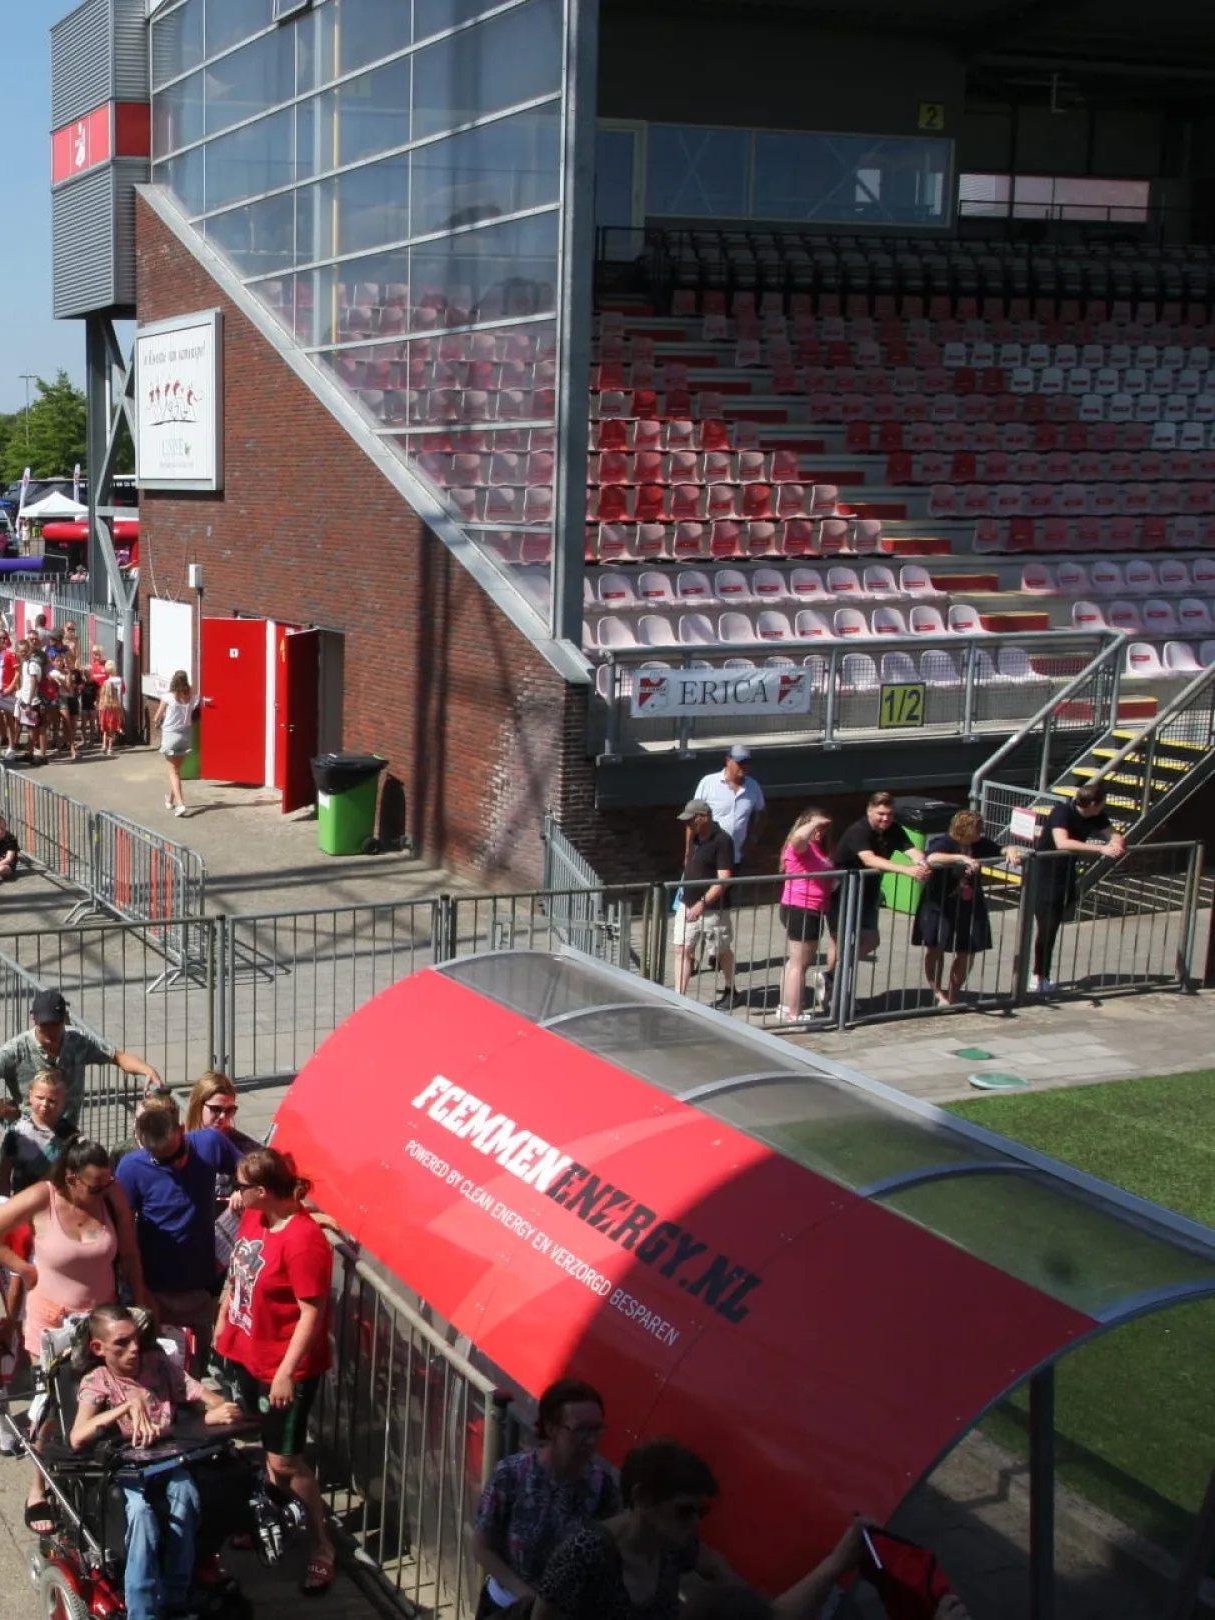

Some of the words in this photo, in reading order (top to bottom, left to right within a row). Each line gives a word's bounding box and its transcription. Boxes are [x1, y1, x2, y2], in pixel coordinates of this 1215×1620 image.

[925, 106, 938, 127] 2
[677, 679, 769, 706] ERICA
[885, 689, 921, 722] 1/2
[404, 1139, 450, 1178] POWERED
[446, 1169, 465, 1188] BY
[459, 1179, 496, 1211] CLEAN
[490, 1201, 537, 1241] ENERGY
[531, 1232, 553, 1253] EN
[550, 1244, 612, 1296] VERZORGD
[609, 1288, 680, 1346] BESPAREN
